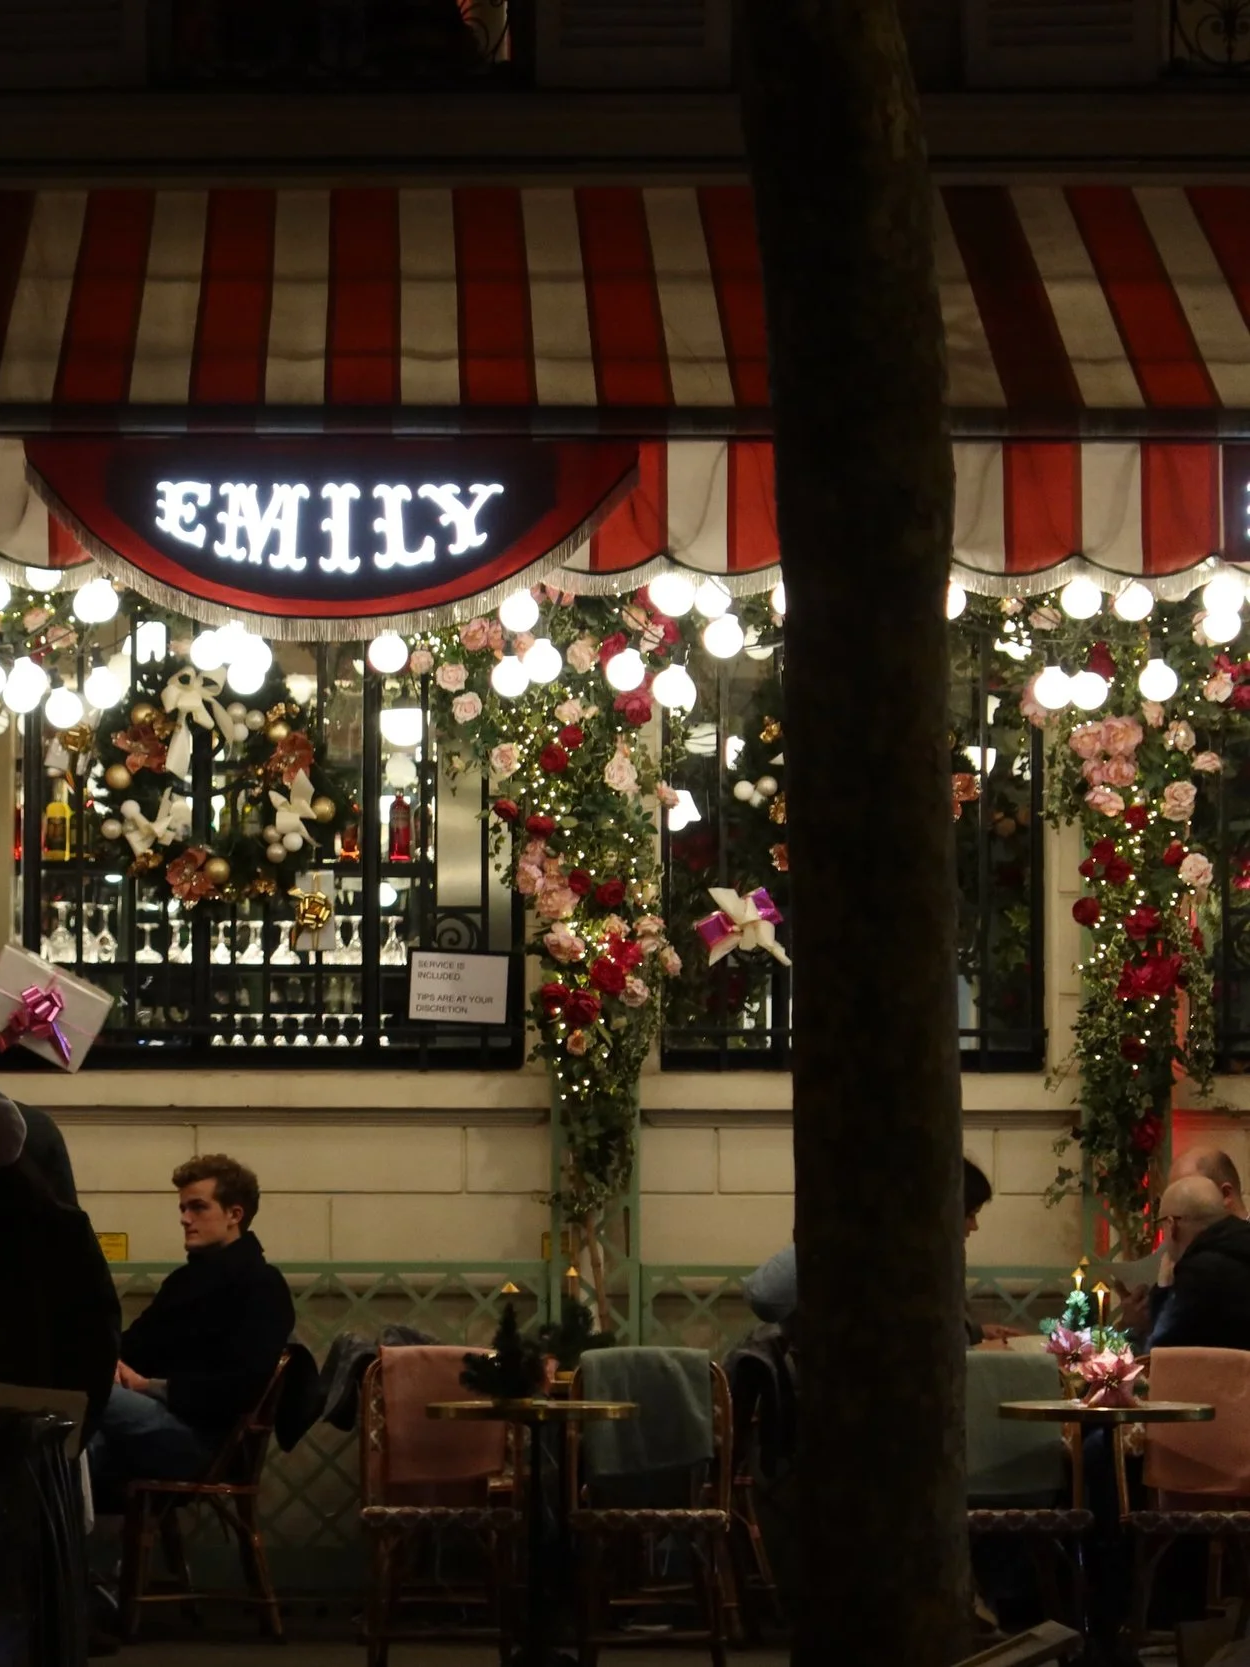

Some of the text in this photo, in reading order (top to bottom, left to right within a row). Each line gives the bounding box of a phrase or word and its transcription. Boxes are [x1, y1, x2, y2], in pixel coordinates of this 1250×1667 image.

[155, 480, 505, 574] EMILY
[417, 960, 465, 970] SERVICE IS
[417, 993, 493, 1004] TIPS ARE AT YOUR
